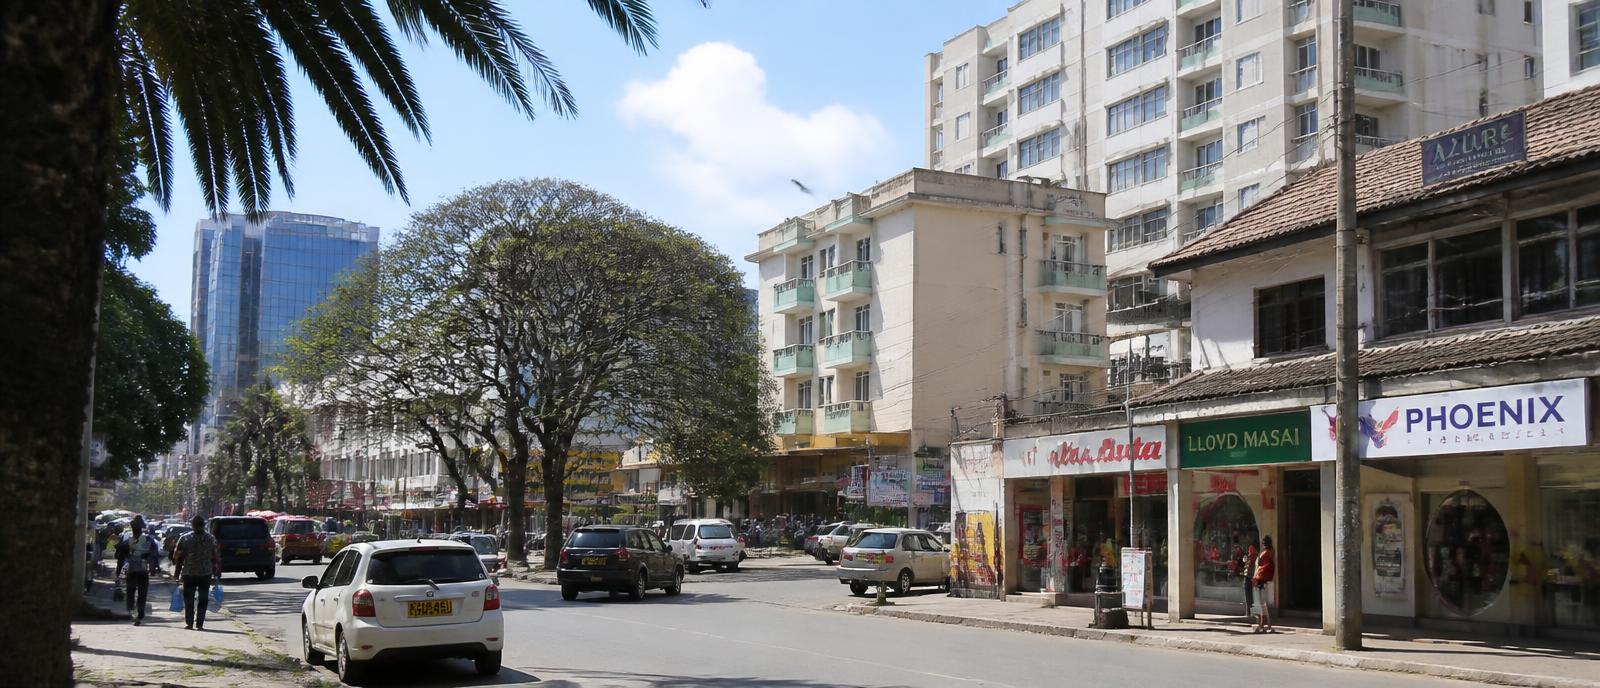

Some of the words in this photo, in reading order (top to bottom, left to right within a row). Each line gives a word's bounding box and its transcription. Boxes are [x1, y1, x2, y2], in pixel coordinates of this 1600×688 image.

[1406, 395, 1565, 433] PHOENIX
[1188, 432, 1238, 452] LLOYD
[1243, 428, 1300, 448] MASAI
